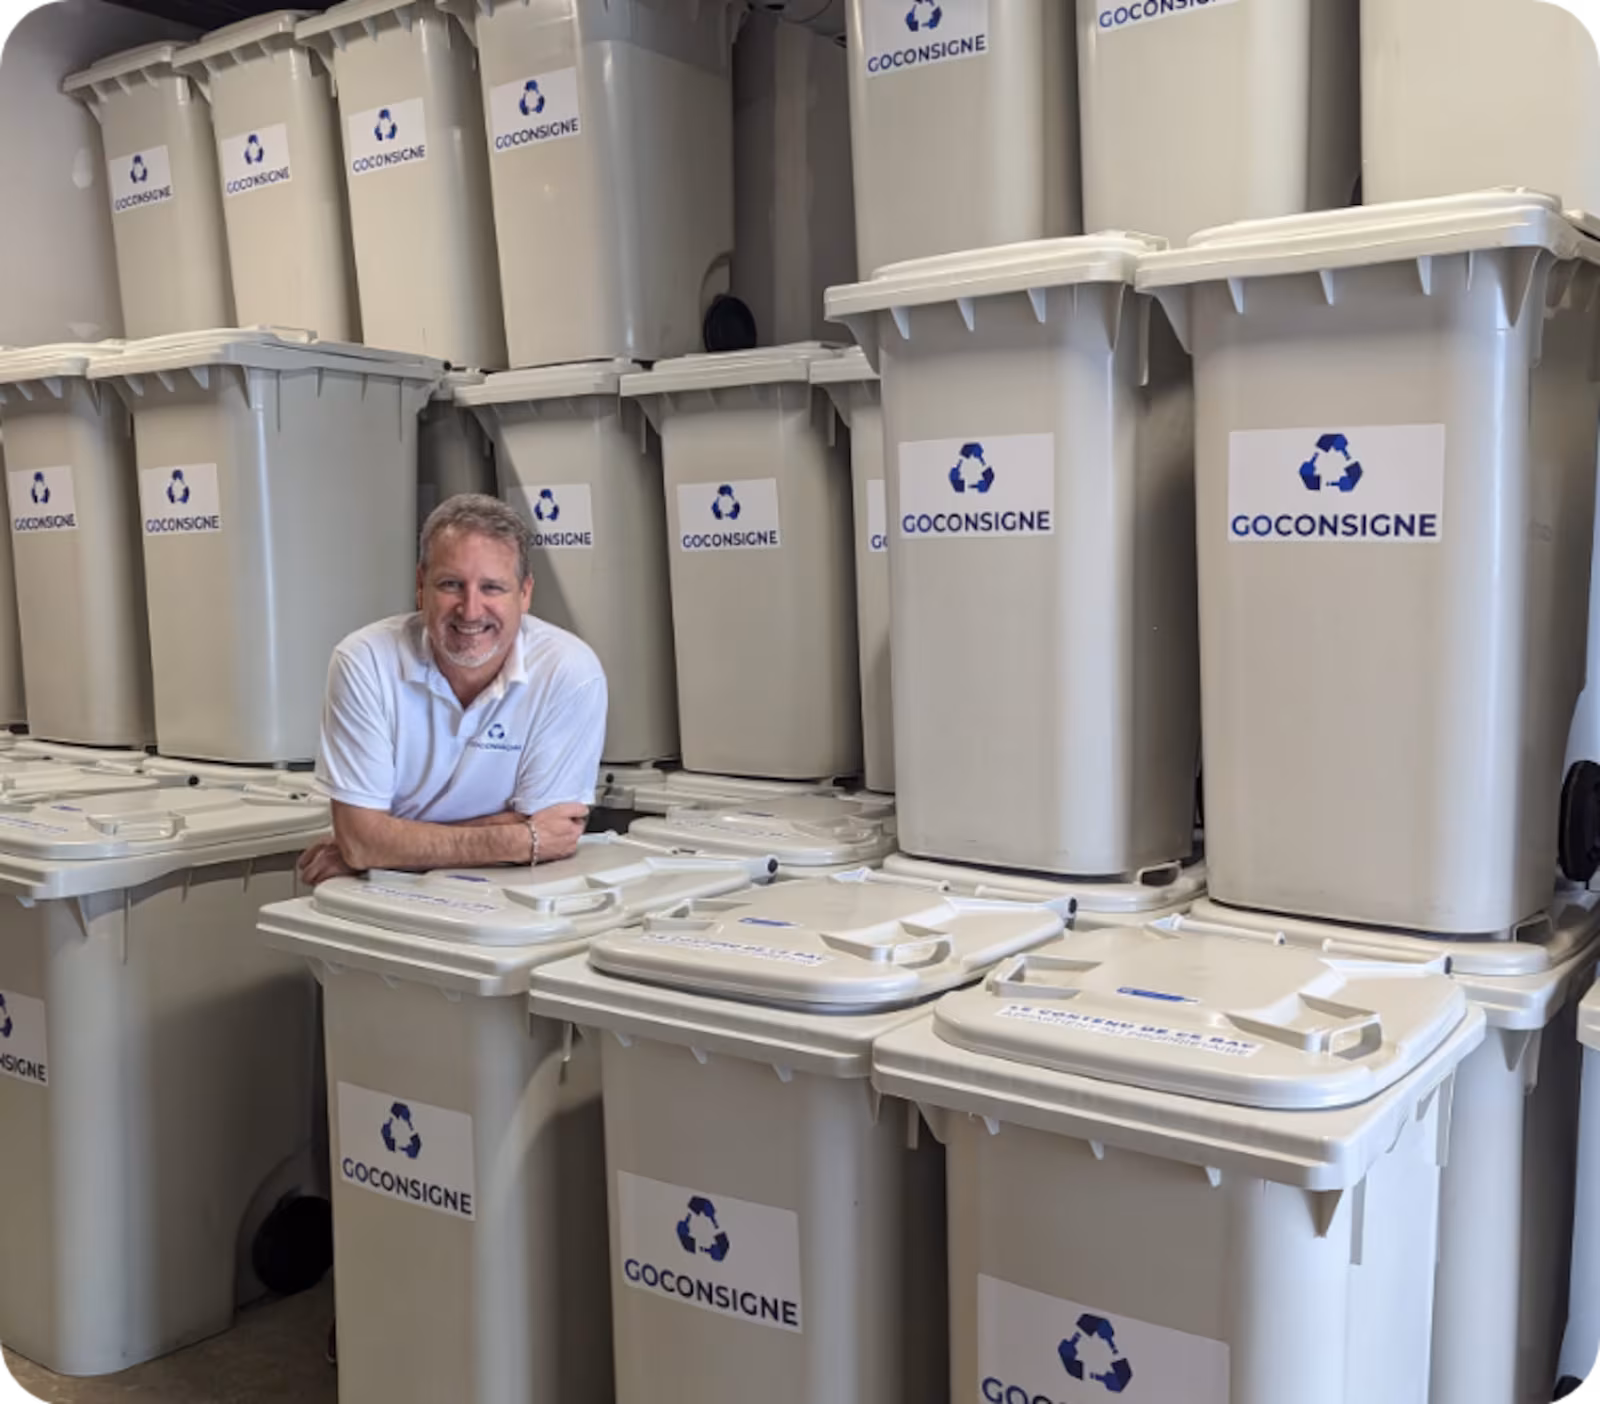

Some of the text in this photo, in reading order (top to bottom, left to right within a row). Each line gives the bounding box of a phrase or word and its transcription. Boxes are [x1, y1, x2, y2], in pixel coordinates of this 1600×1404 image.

[868, 34, 986, 72] GOCONSIGNE
[495, 118, 579, 149] GOCONSIGNE
[352, 145, 425, 172] GOCONSIGNE
[146, 515, 219, 532] GOCONSIGNE
[902, 510, 1051, 533] GOCONSIGNE
[1231, 514, 1437, 536] GOCONSIGNE
[682, 530, 778, 548] GOCONSIGNE
[343, 1158, 472, 1215] GOCONSIGNE
[624, 1258, 798, 1326] GOCONSIGNE
